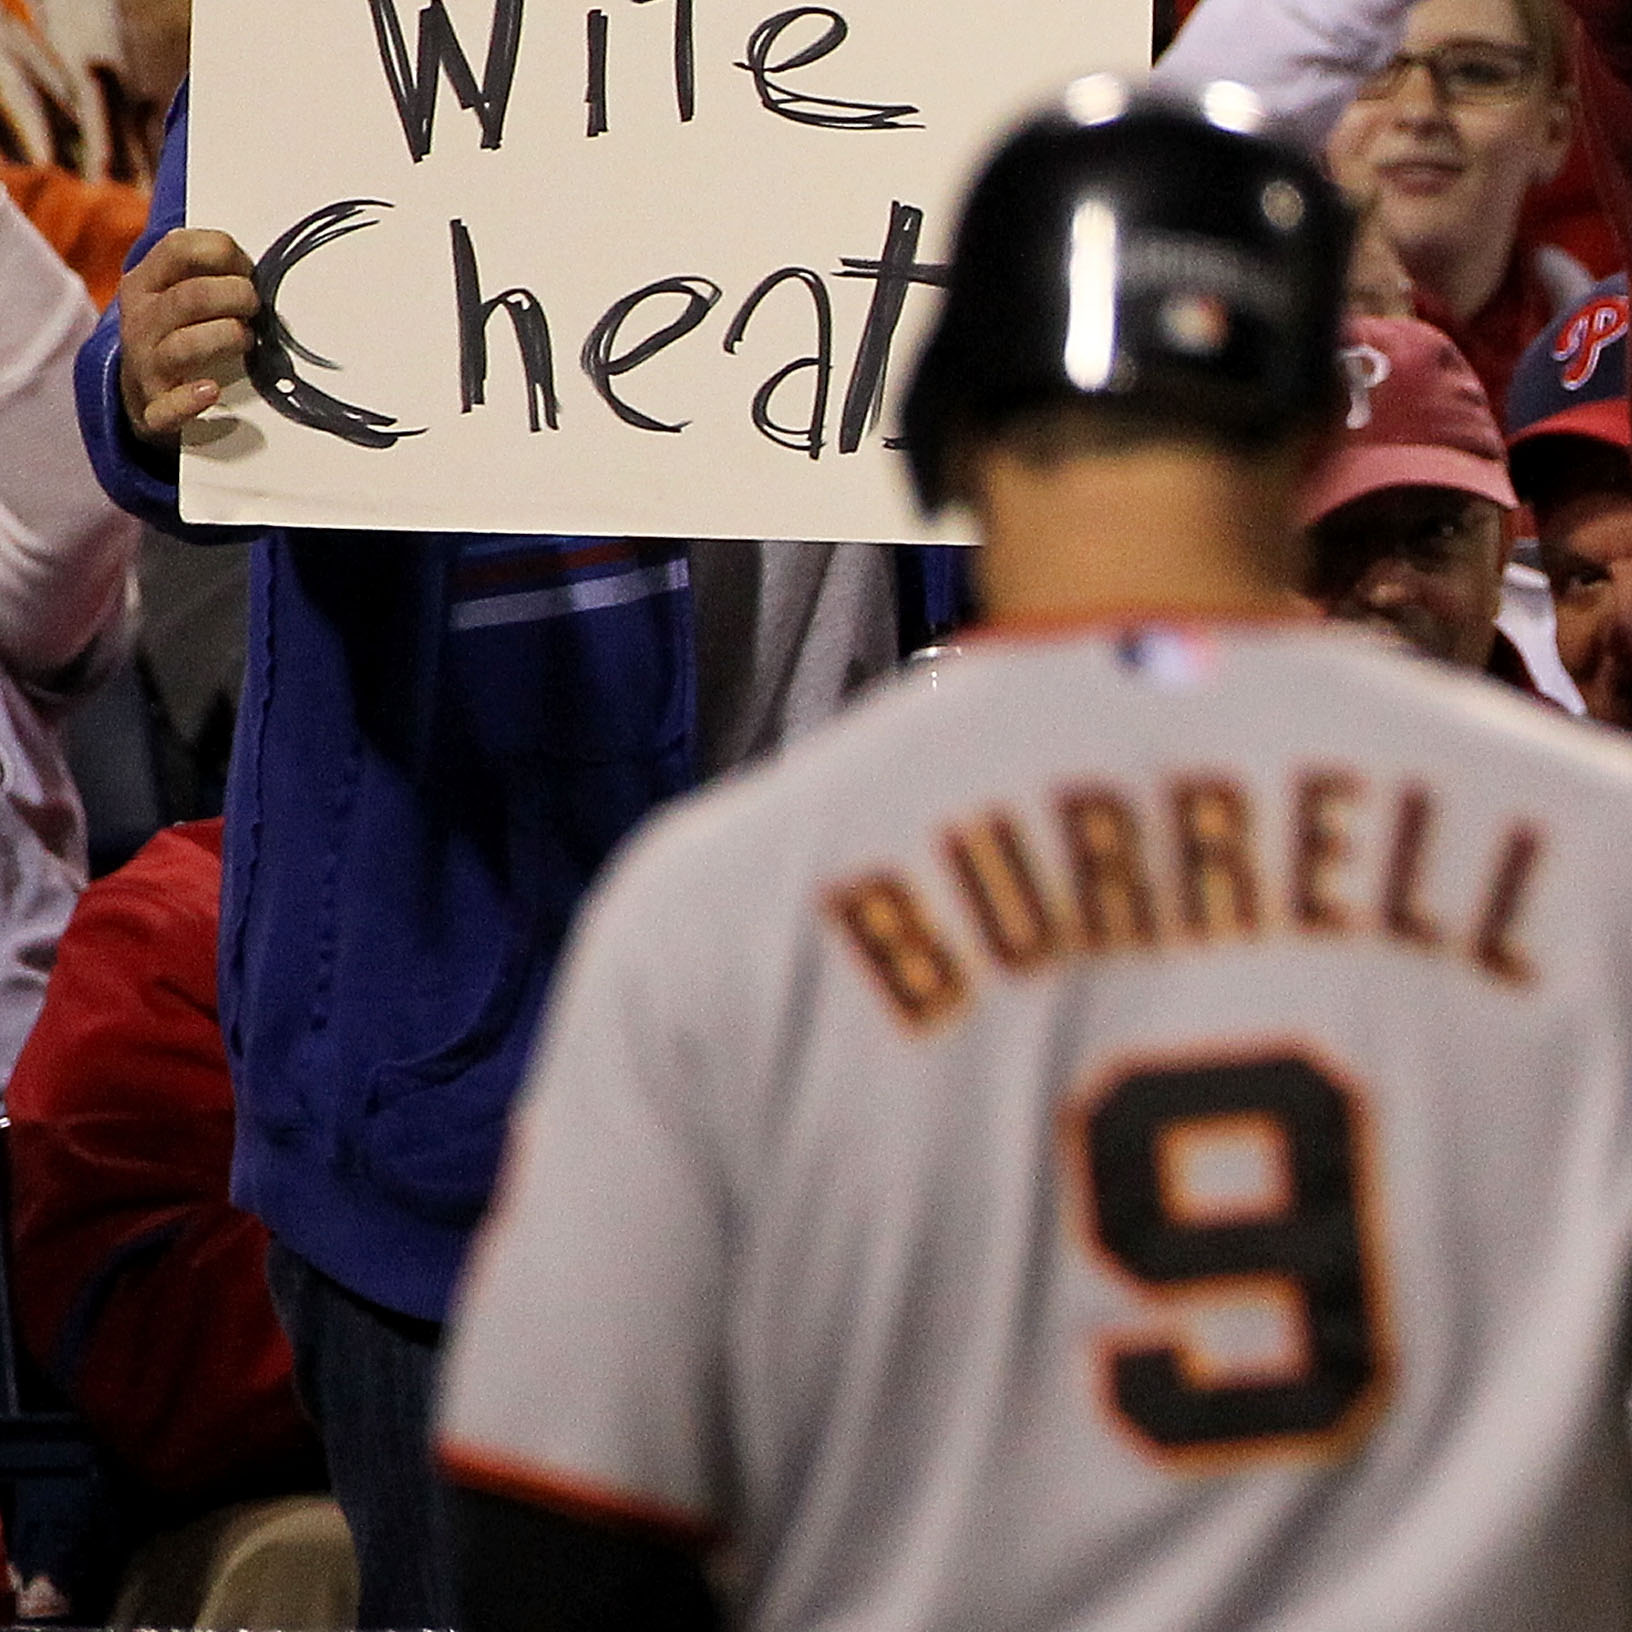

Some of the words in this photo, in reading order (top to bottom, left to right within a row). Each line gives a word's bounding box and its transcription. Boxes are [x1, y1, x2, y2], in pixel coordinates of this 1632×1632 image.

[246, 201, 950, 460] Cheat
[828, 768, 1540, 1030] BURRELL
[1064, 1038, 1398, 1473] 9
